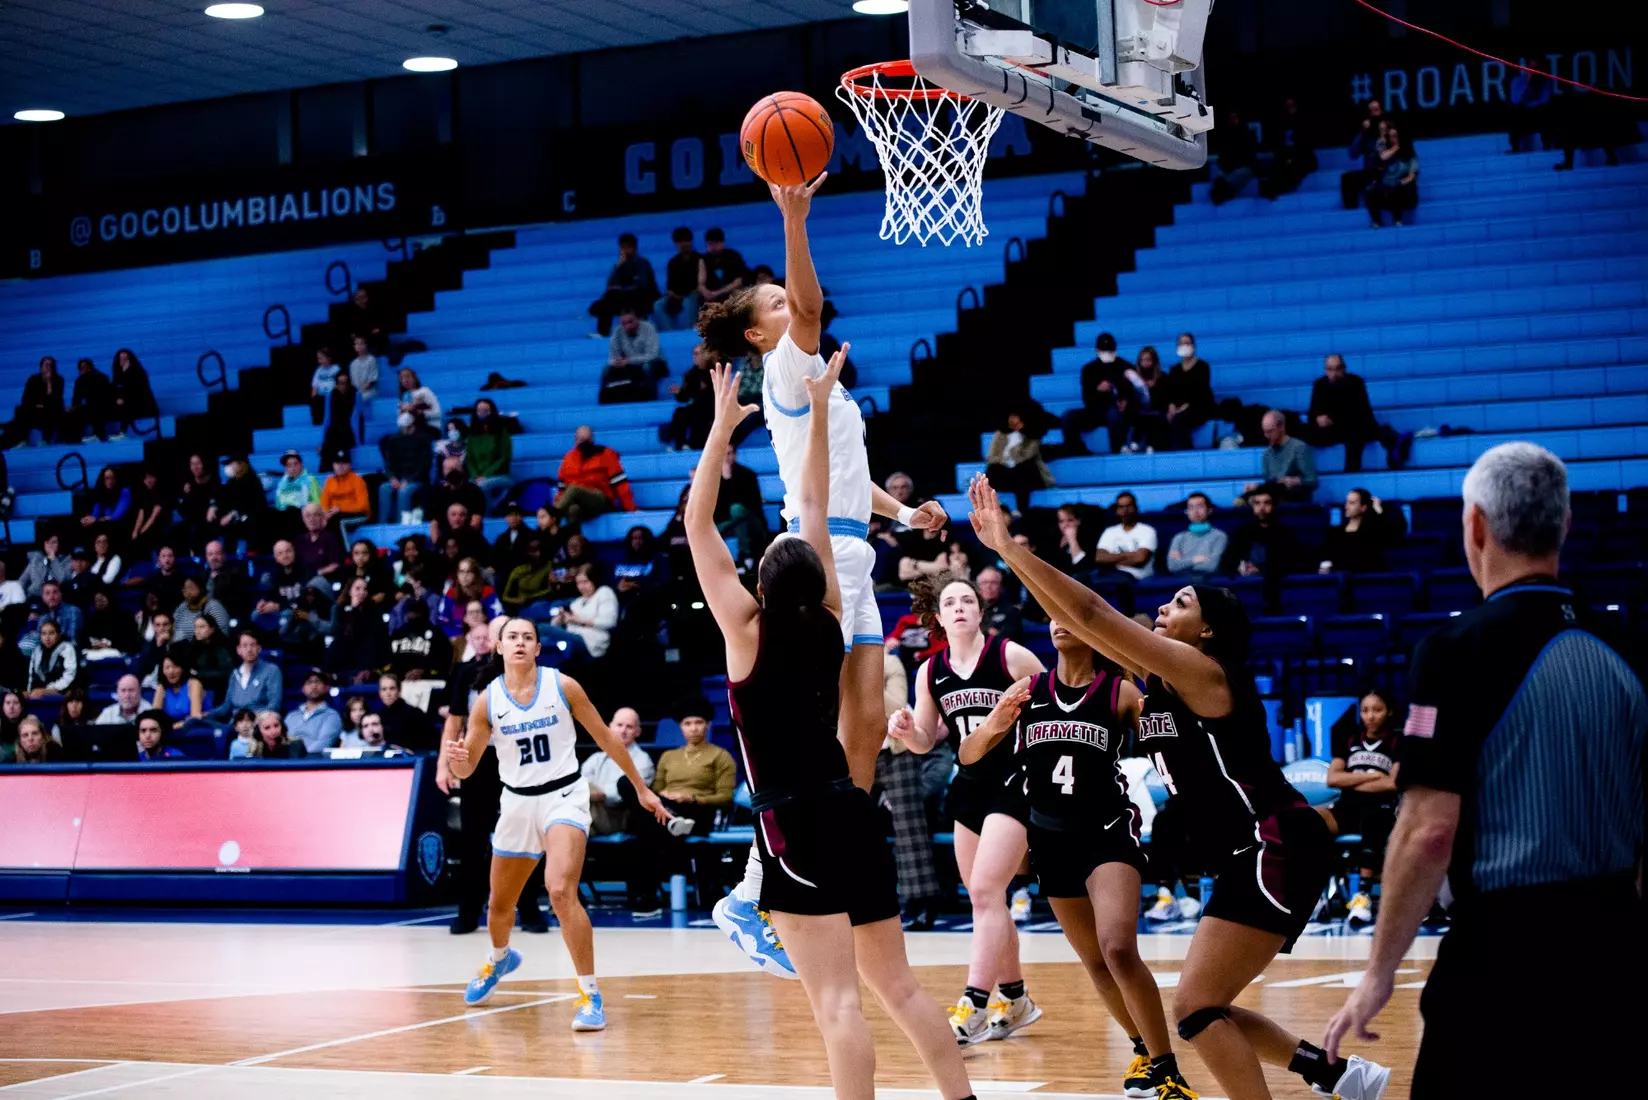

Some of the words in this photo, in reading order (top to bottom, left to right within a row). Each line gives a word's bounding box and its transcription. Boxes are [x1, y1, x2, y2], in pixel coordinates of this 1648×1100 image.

[1351, 47, 1633, 113] #ROARION
[624, 108, 1033, 195] COLMBIA
[70, 182, 396, 247] @GOCOLUMBIALIONS
[499, 714, 560, 736] COLUMBIA
[1027, 721, 1108, 748] LAFAYETTE
[515, 733, 552, 767] 20
[1052, 755, 1075, 795] 4
